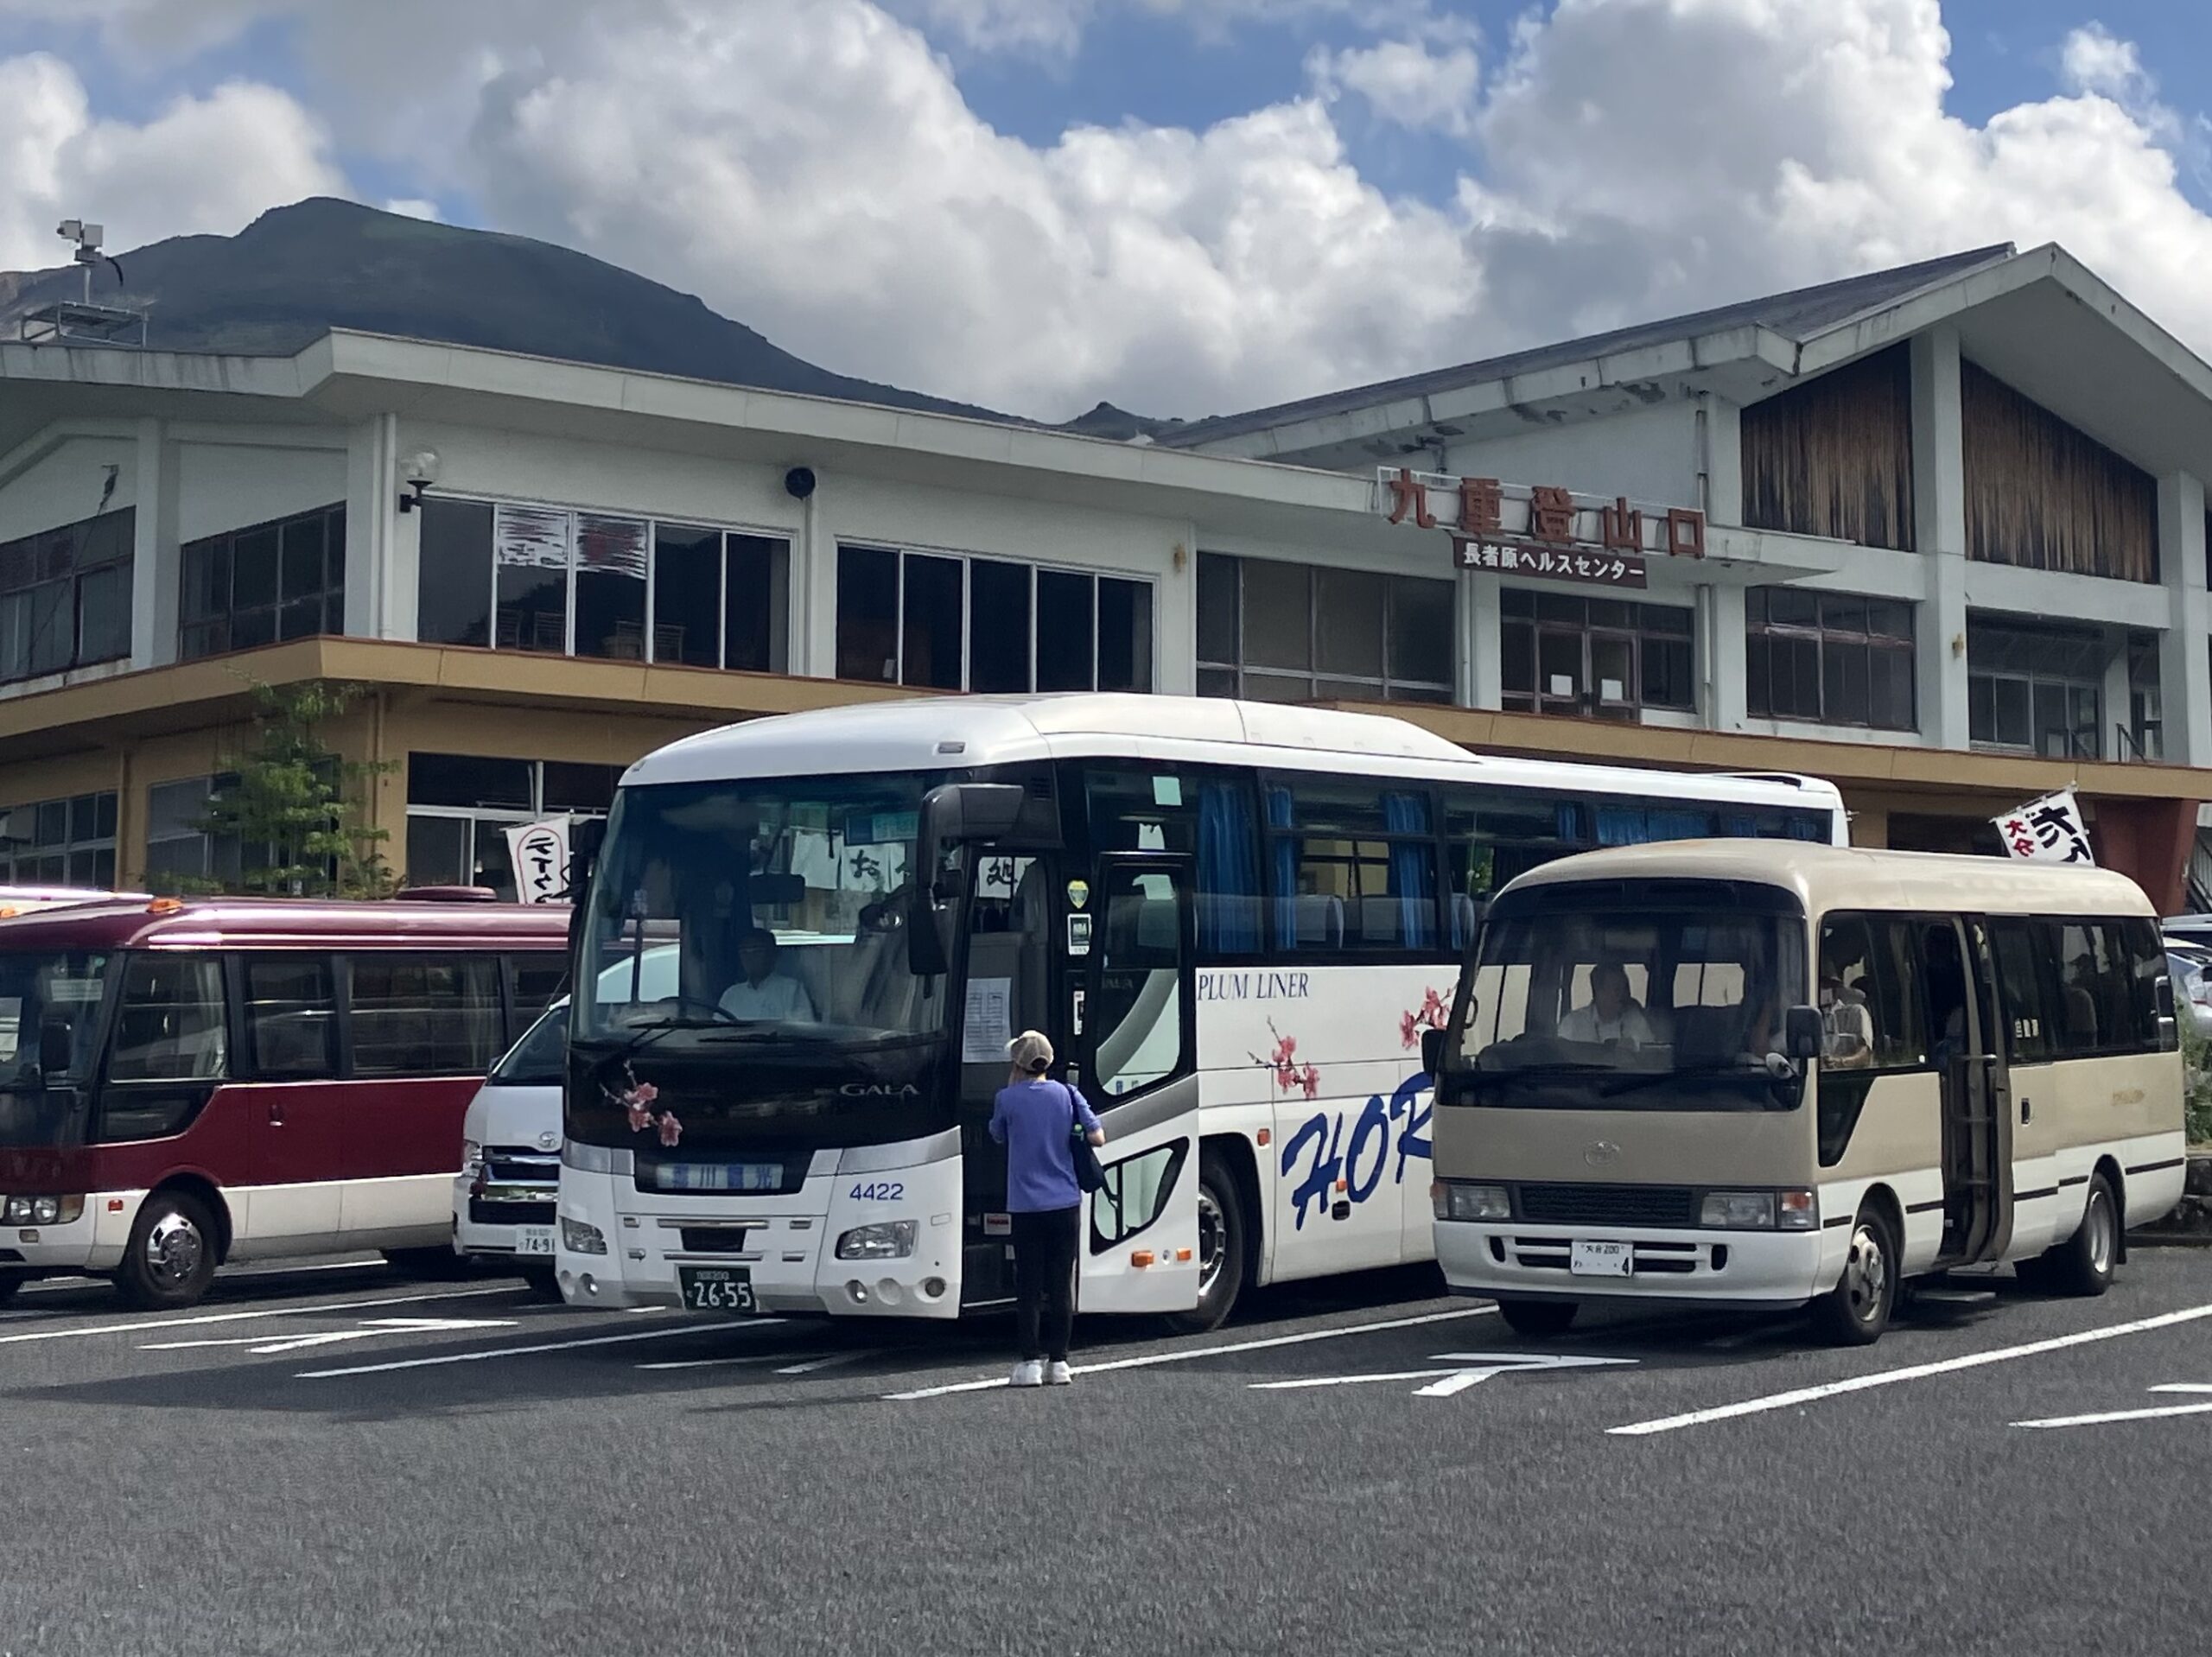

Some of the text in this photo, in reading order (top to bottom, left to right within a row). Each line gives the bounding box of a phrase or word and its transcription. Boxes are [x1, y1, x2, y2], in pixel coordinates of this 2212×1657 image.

[1389, 467, 1706, 560] 九重登山口
[1464, 542, 1644, 581] 長者原ヘルスセンター
[1198, 972, 1309, 1000] PLUM LINER
[840, 1083, 920, 1097] GALA
[849, 1183, 904, 1202] 4422
[694, 1282, 751, 1307] 26-55
